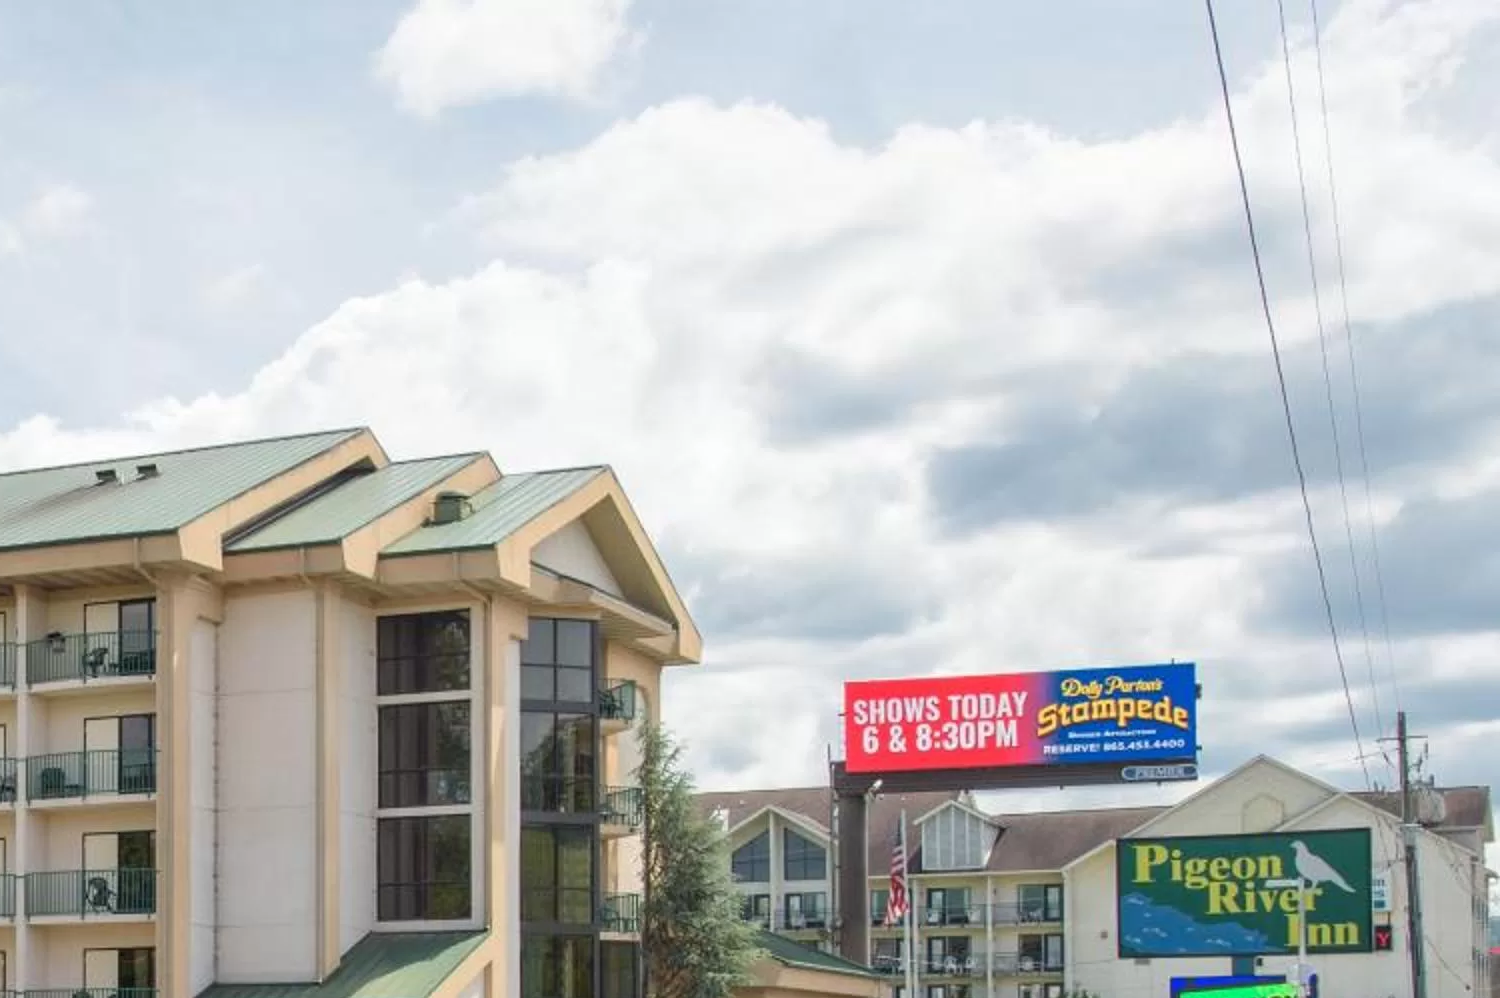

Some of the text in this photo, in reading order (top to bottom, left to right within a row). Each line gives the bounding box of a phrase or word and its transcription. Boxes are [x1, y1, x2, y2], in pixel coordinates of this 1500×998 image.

[1060, 677, 1104, 699] Dolly
[853, 691, 1028, 725] SHOWS TODAY
[1037, 696, 1189, 737] Stampede
[863, 719, 1019, 754] 6 & 8:30PM
[1130, 843, 1284, 889] Pigeon
[1205, 880, 1323, 915] River
[1284, 913, 1361, 947] Inn
